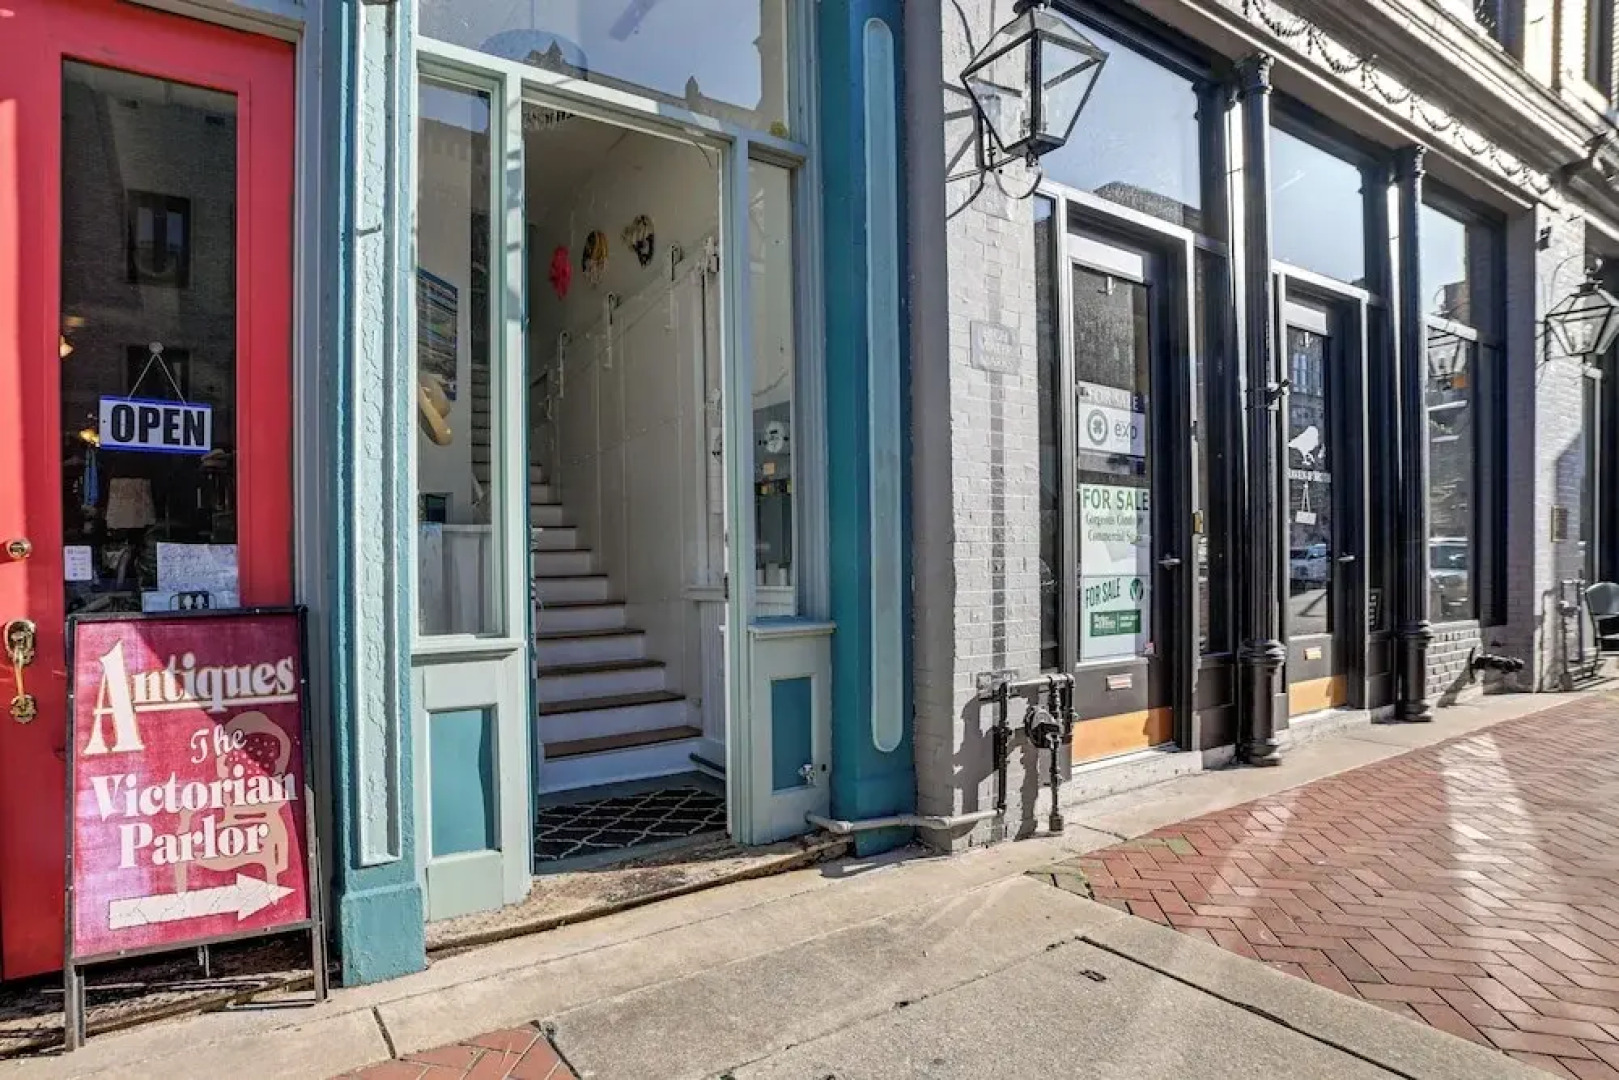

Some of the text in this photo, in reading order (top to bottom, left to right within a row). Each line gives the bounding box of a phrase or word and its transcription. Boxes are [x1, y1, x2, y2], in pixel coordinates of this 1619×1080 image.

[111, 404, 205, 447] OPEN
[1082, 488, 1149, 511] FOR SALE
[1086, 577, 1121, 609] FOR SALE
[84, 638, 295, 756] Antiques
[190, 723, 248, 764] The
[89, 764, 298, 823] Victorian
[118, 815, 271, 869] Parlor
